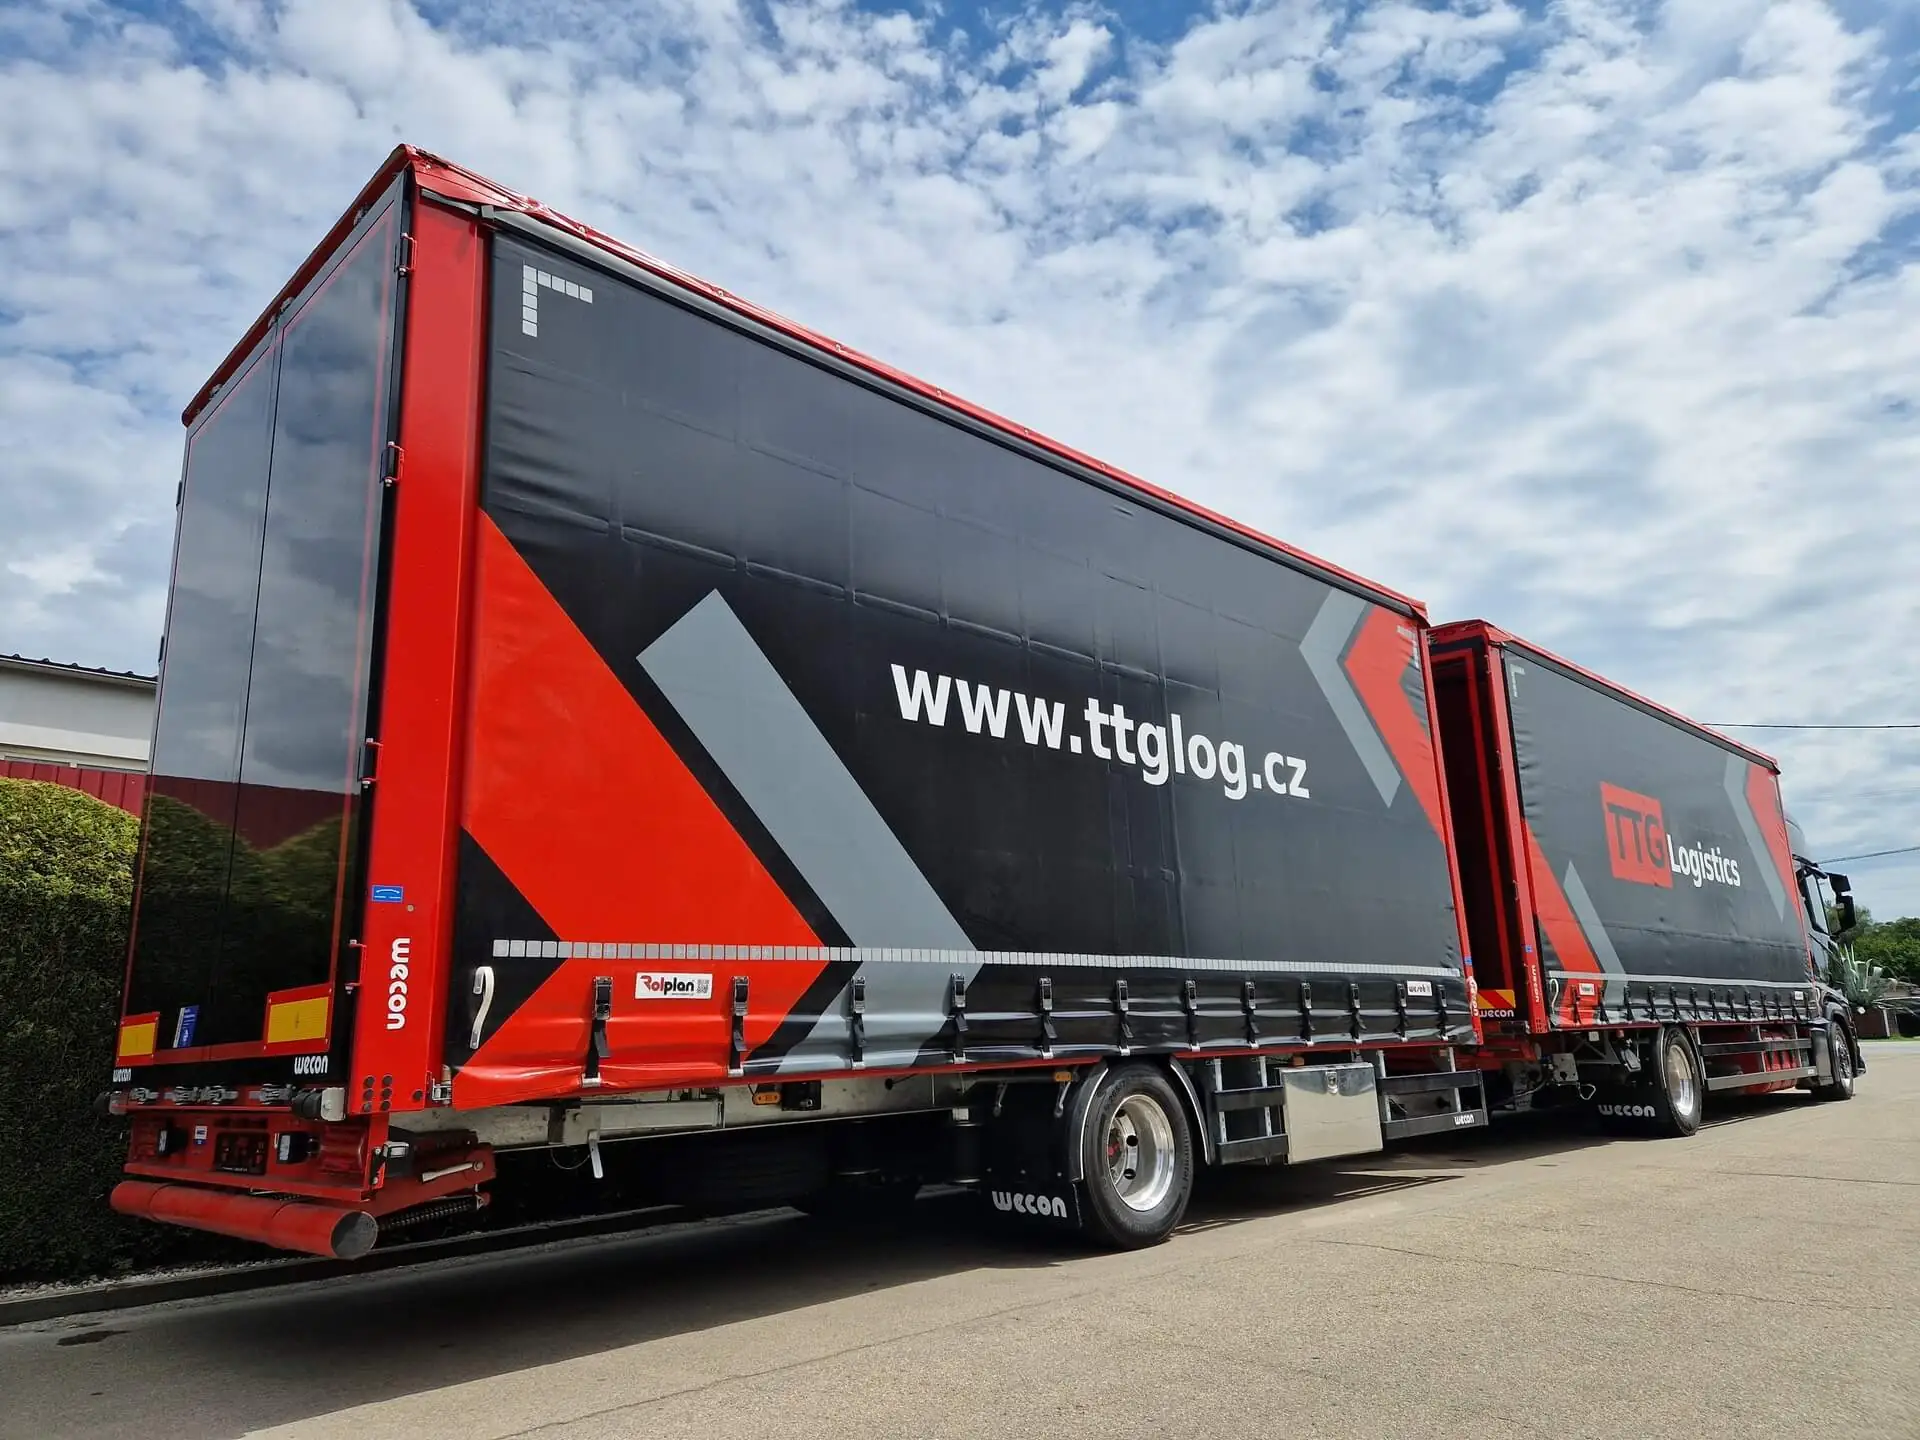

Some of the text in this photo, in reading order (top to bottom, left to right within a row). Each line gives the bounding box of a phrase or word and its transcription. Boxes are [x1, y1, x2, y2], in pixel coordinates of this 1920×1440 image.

[890, 663, 1311, 800] www.ttglog.cz
[1605, 801, 1741, 888] TTG Logistics
[386, 937, 411, 1030] wecon
[640, 975, 694, 995] Rolplan
[1479, 1009, 1515, 1018] wecon
[294, 1055, 329, 1075] wecon
[1454, 1113, 1475, 1126] wecon
[1597, 1104, 1656, 1118] wecon
[991, 1190, 1068, 1219] wecon
